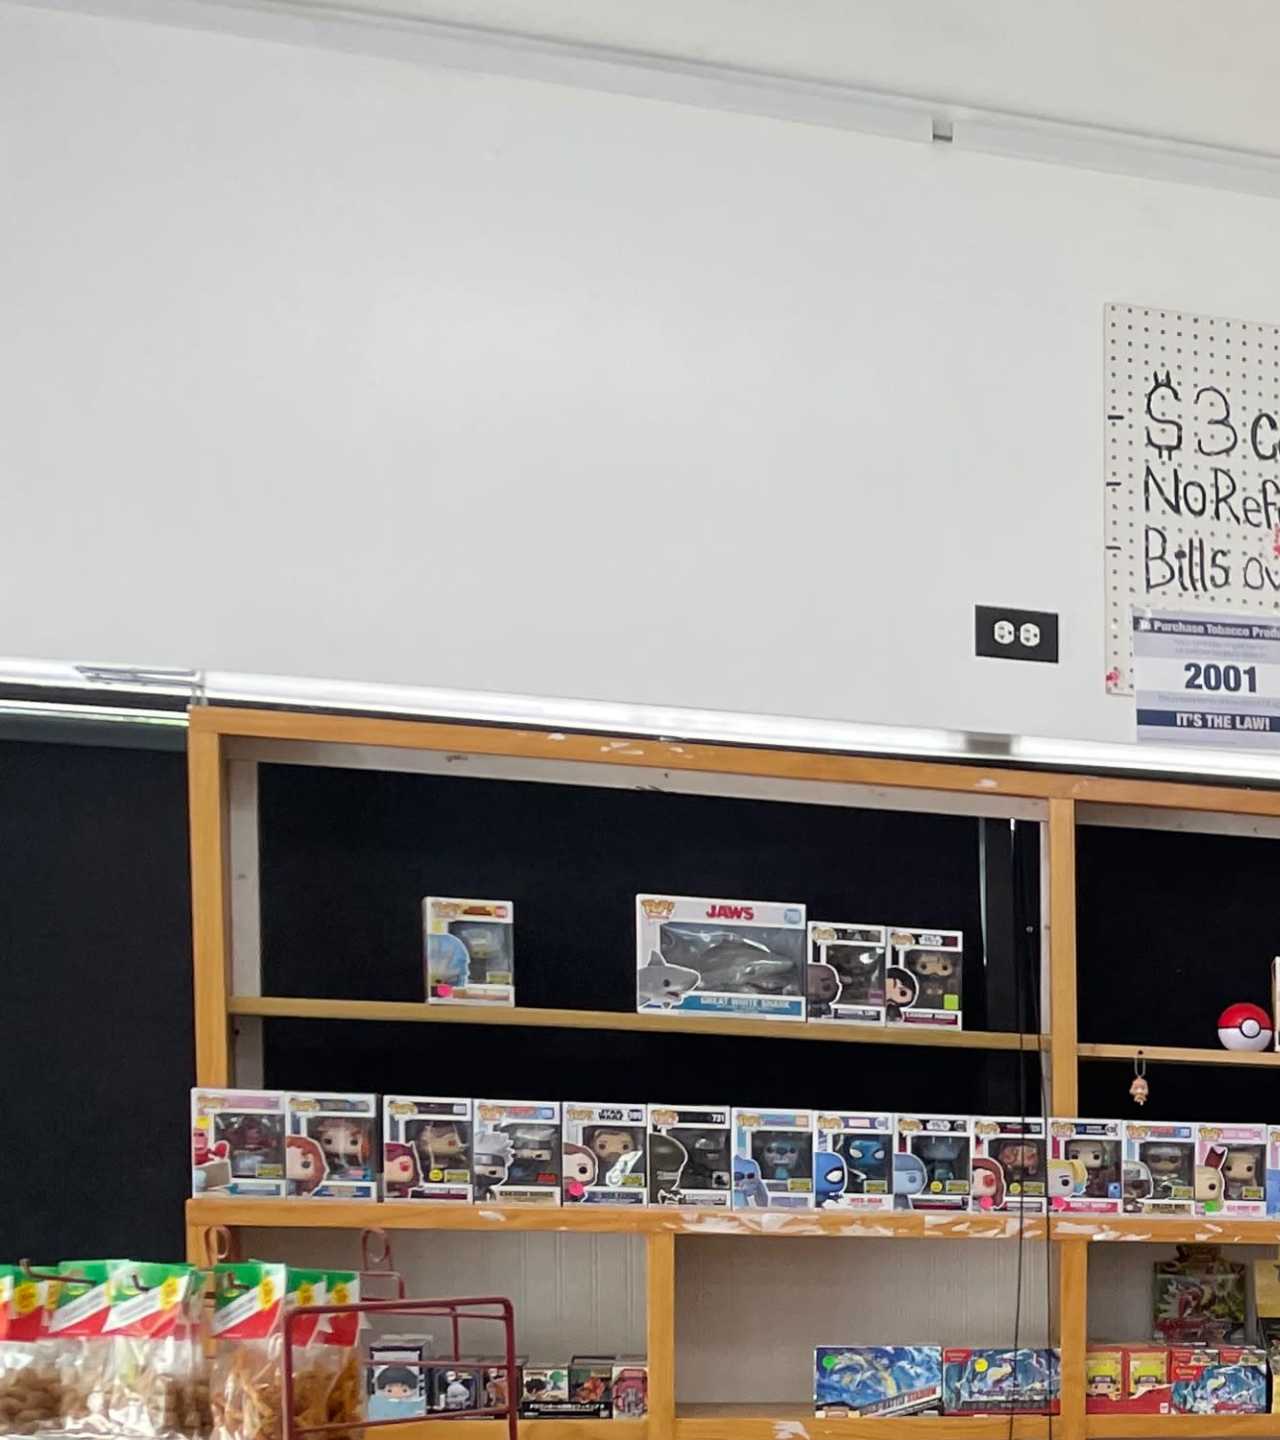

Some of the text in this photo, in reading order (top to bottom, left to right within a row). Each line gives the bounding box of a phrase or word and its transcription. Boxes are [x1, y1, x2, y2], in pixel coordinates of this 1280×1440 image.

[1145, 524, 1231, 594] Bills
[1184, 662, 1256, 693] 2001
[1176, 712, 1271, 731] IT'S THE LAW!
[706, 904, 754, 921] JAWS
